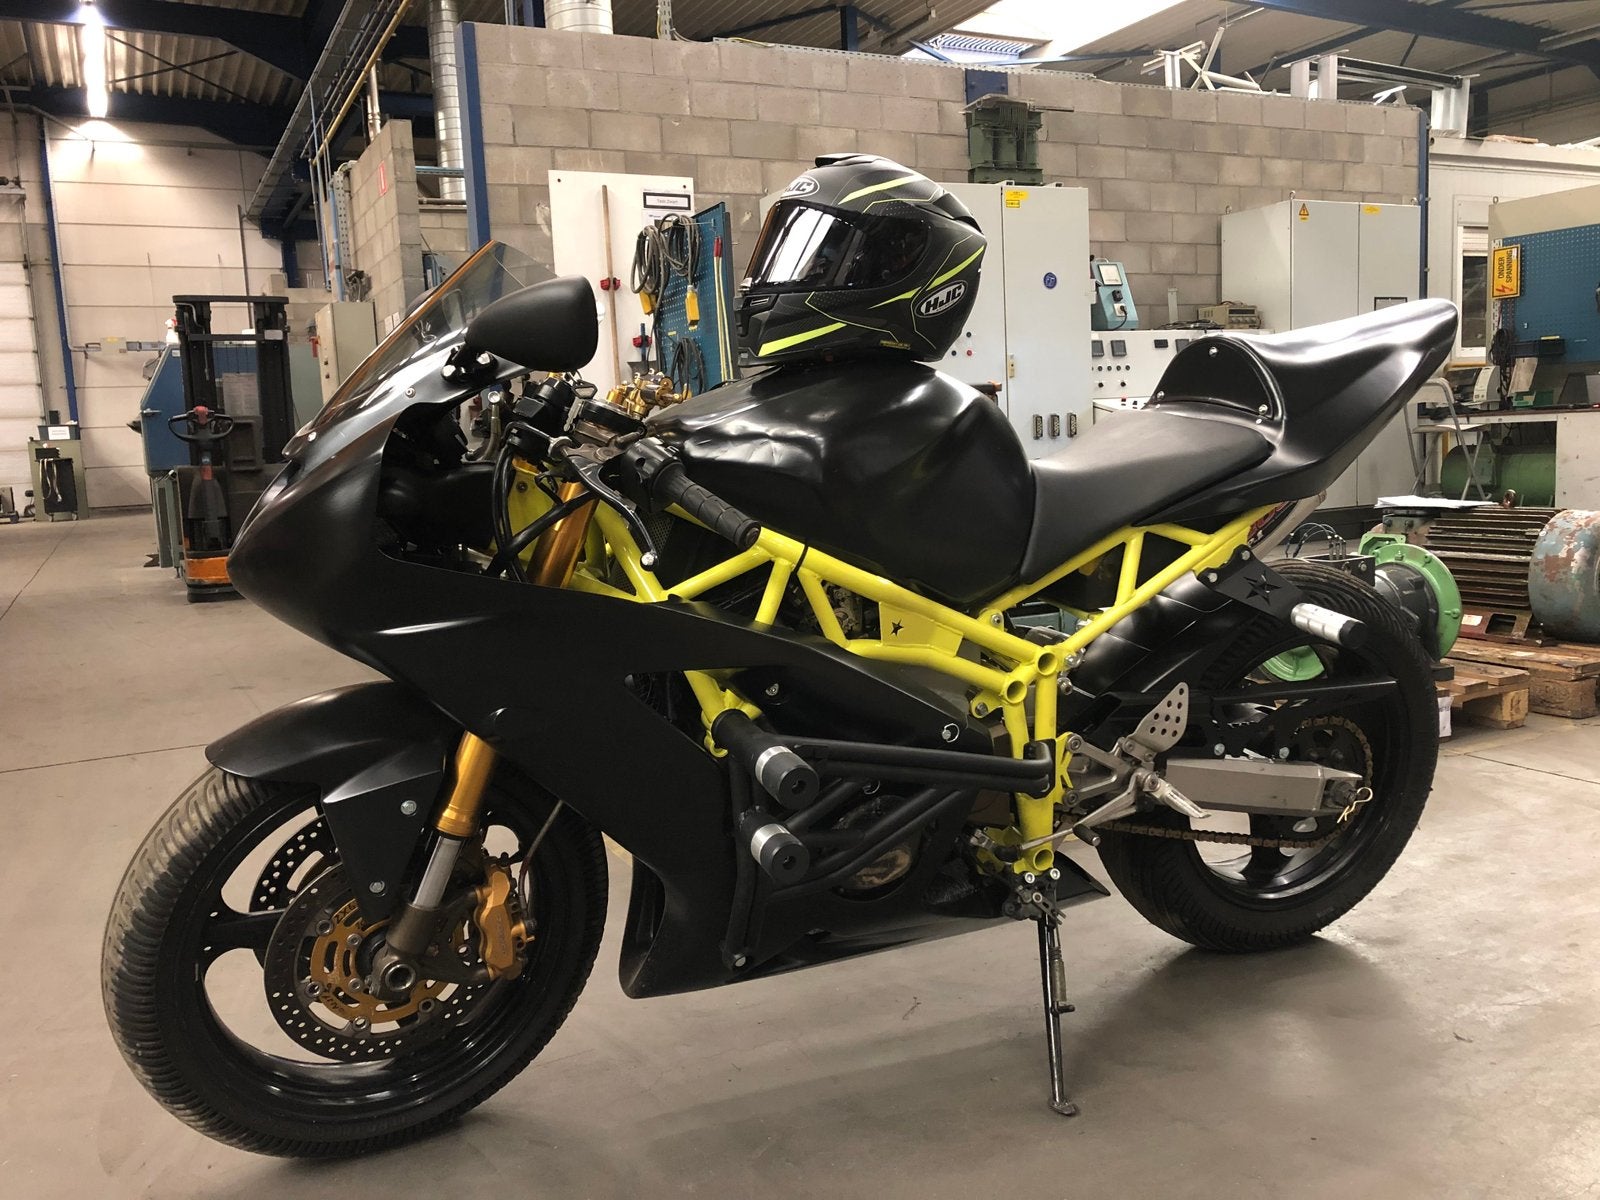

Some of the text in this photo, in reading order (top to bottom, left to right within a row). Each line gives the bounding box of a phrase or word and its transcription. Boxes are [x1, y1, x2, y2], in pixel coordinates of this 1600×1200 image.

[784, 181, 813, 192] JC
[1497, 256, 1505, 279] ONDER
[1505, 250, 1513, 283] SPANNING
[924, 283, 963, 314] HJC
